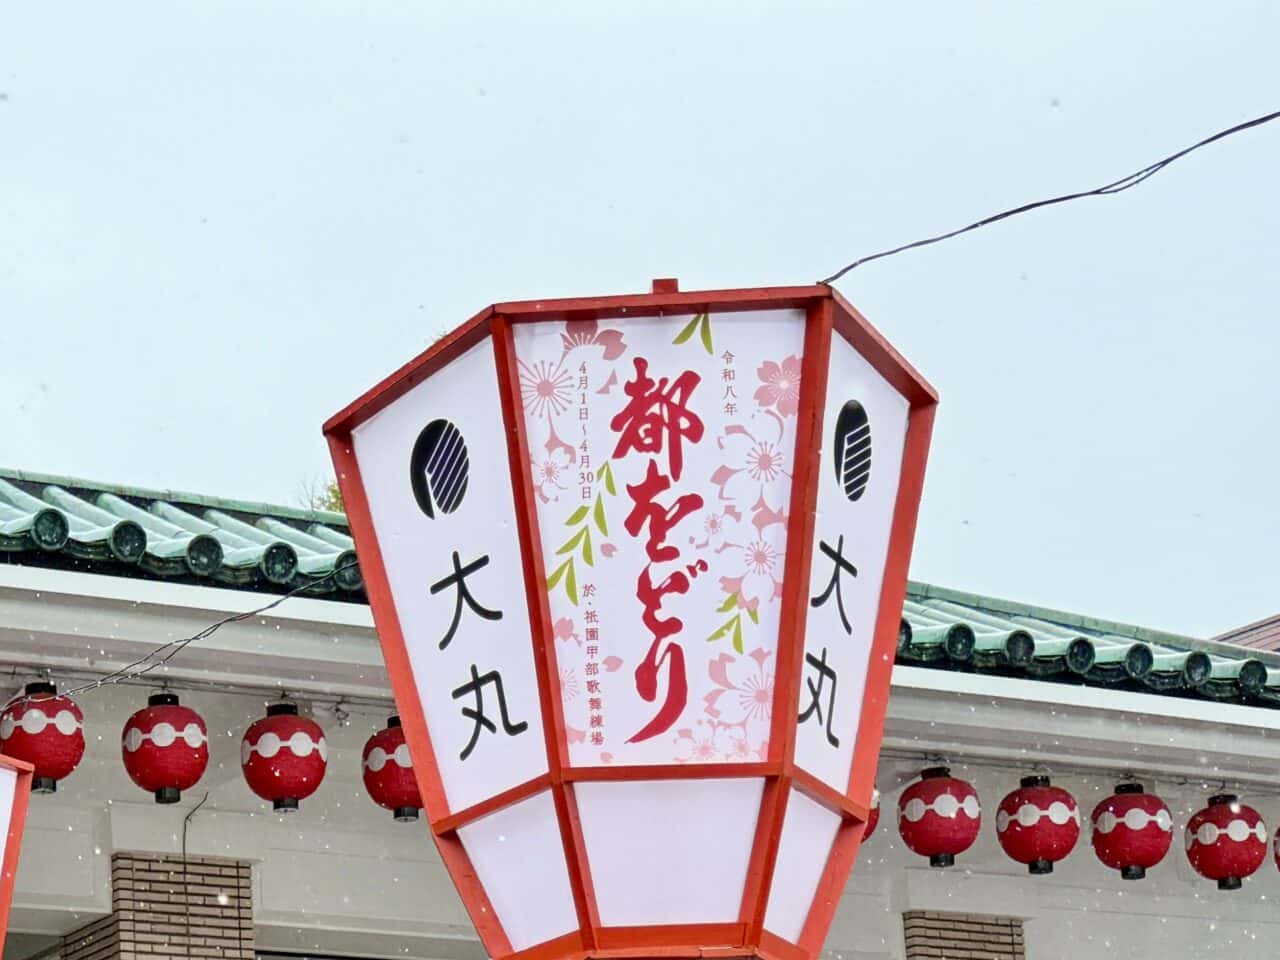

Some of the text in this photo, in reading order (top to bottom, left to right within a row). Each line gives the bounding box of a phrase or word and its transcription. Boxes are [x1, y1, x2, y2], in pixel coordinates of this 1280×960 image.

[721, 349, 737, 416] 令和八年
[429, 550, 528, 761] 大丸
[611, 356, 708, 743] 都をどり
[798, 533, 858, 749] 大丸
